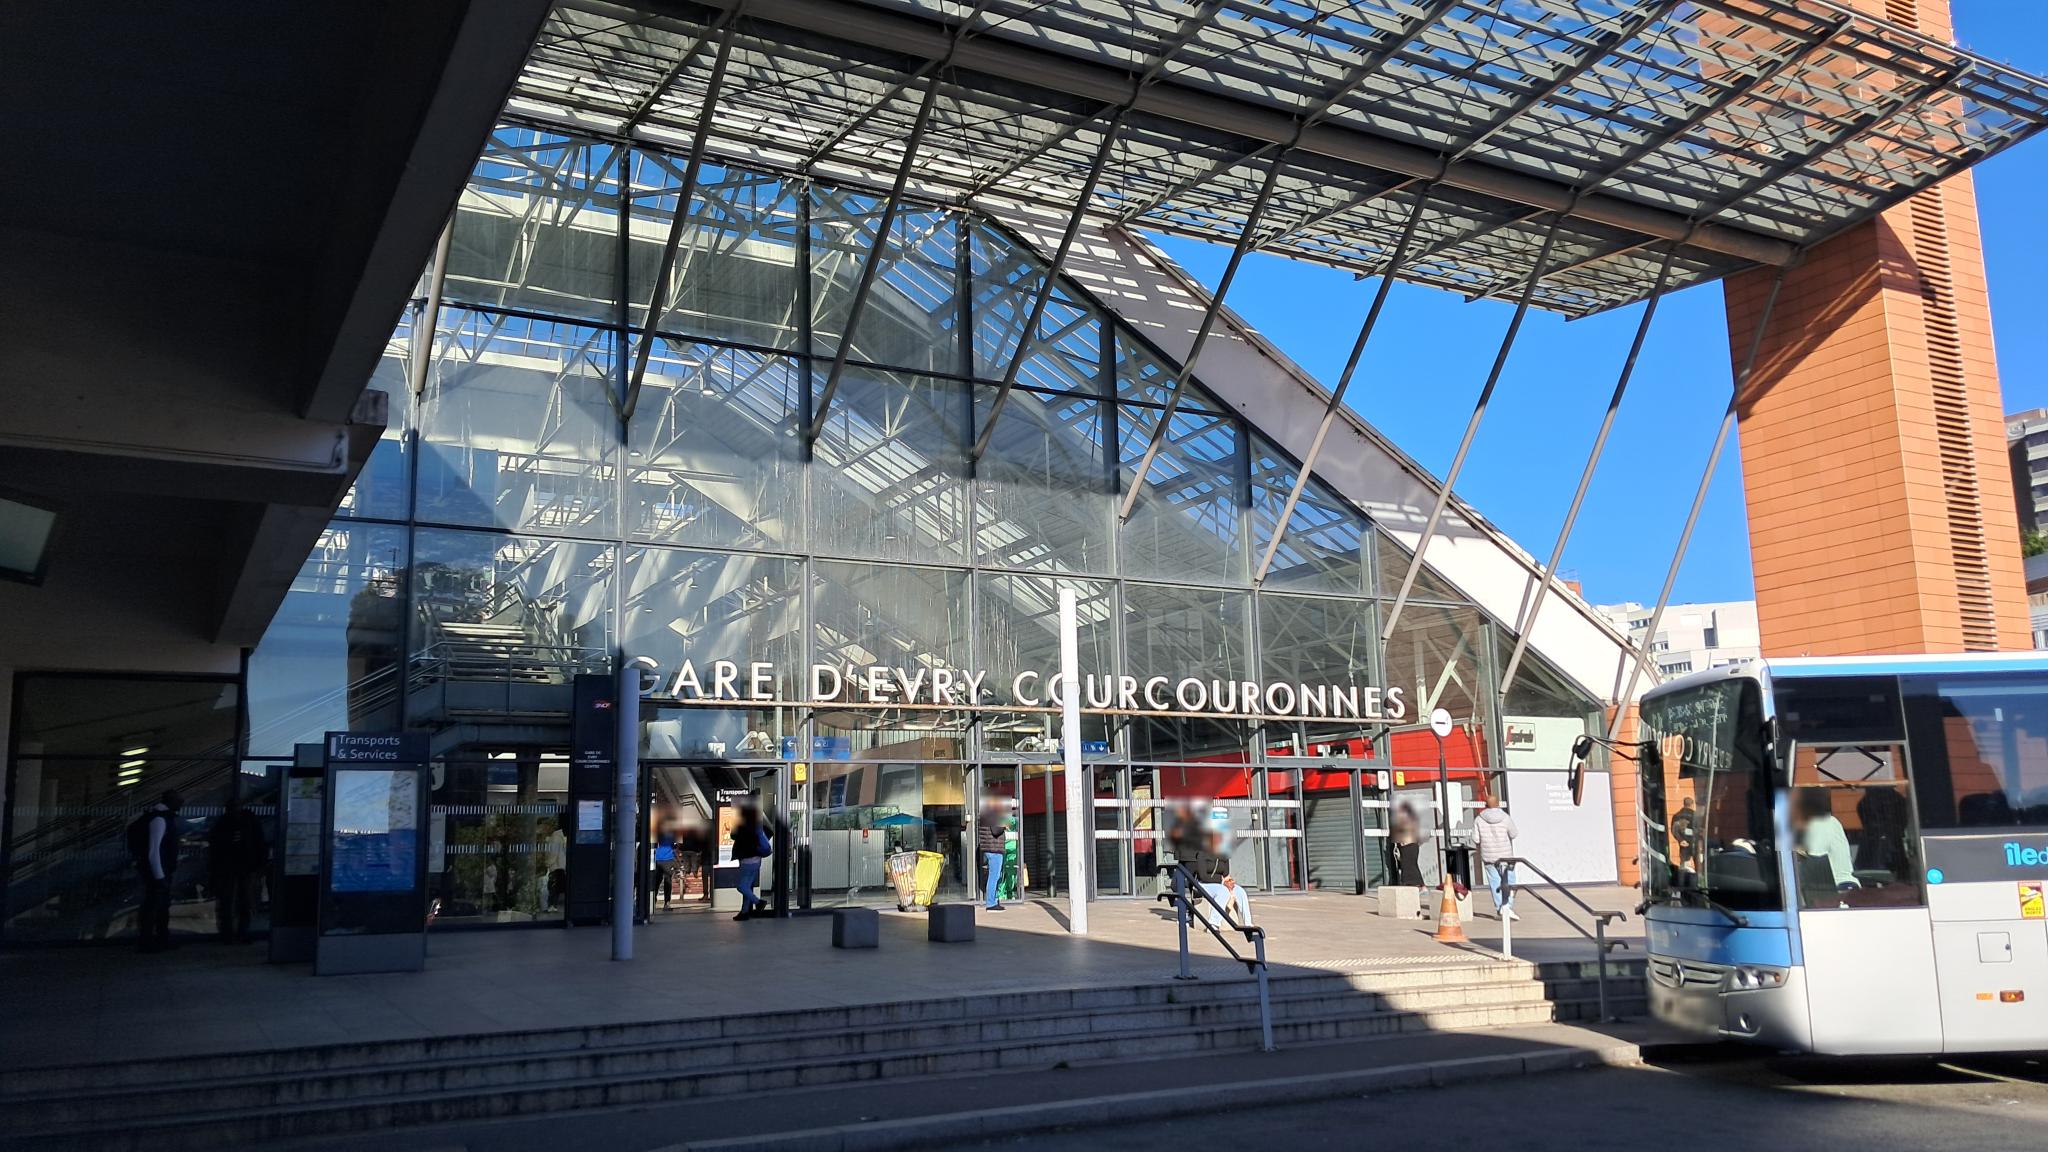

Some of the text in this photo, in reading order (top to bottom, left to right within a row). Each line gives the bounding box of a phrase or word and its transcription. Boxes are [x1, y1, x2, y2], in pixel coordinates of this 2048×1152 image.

[624, 655, 1407, 719] GARE D'EVRY COURCOURONNES
[338, 735, 400, 746] Transports
[338, 749, 398, 759] & Services
[720, 788, 749, 796] Transports
